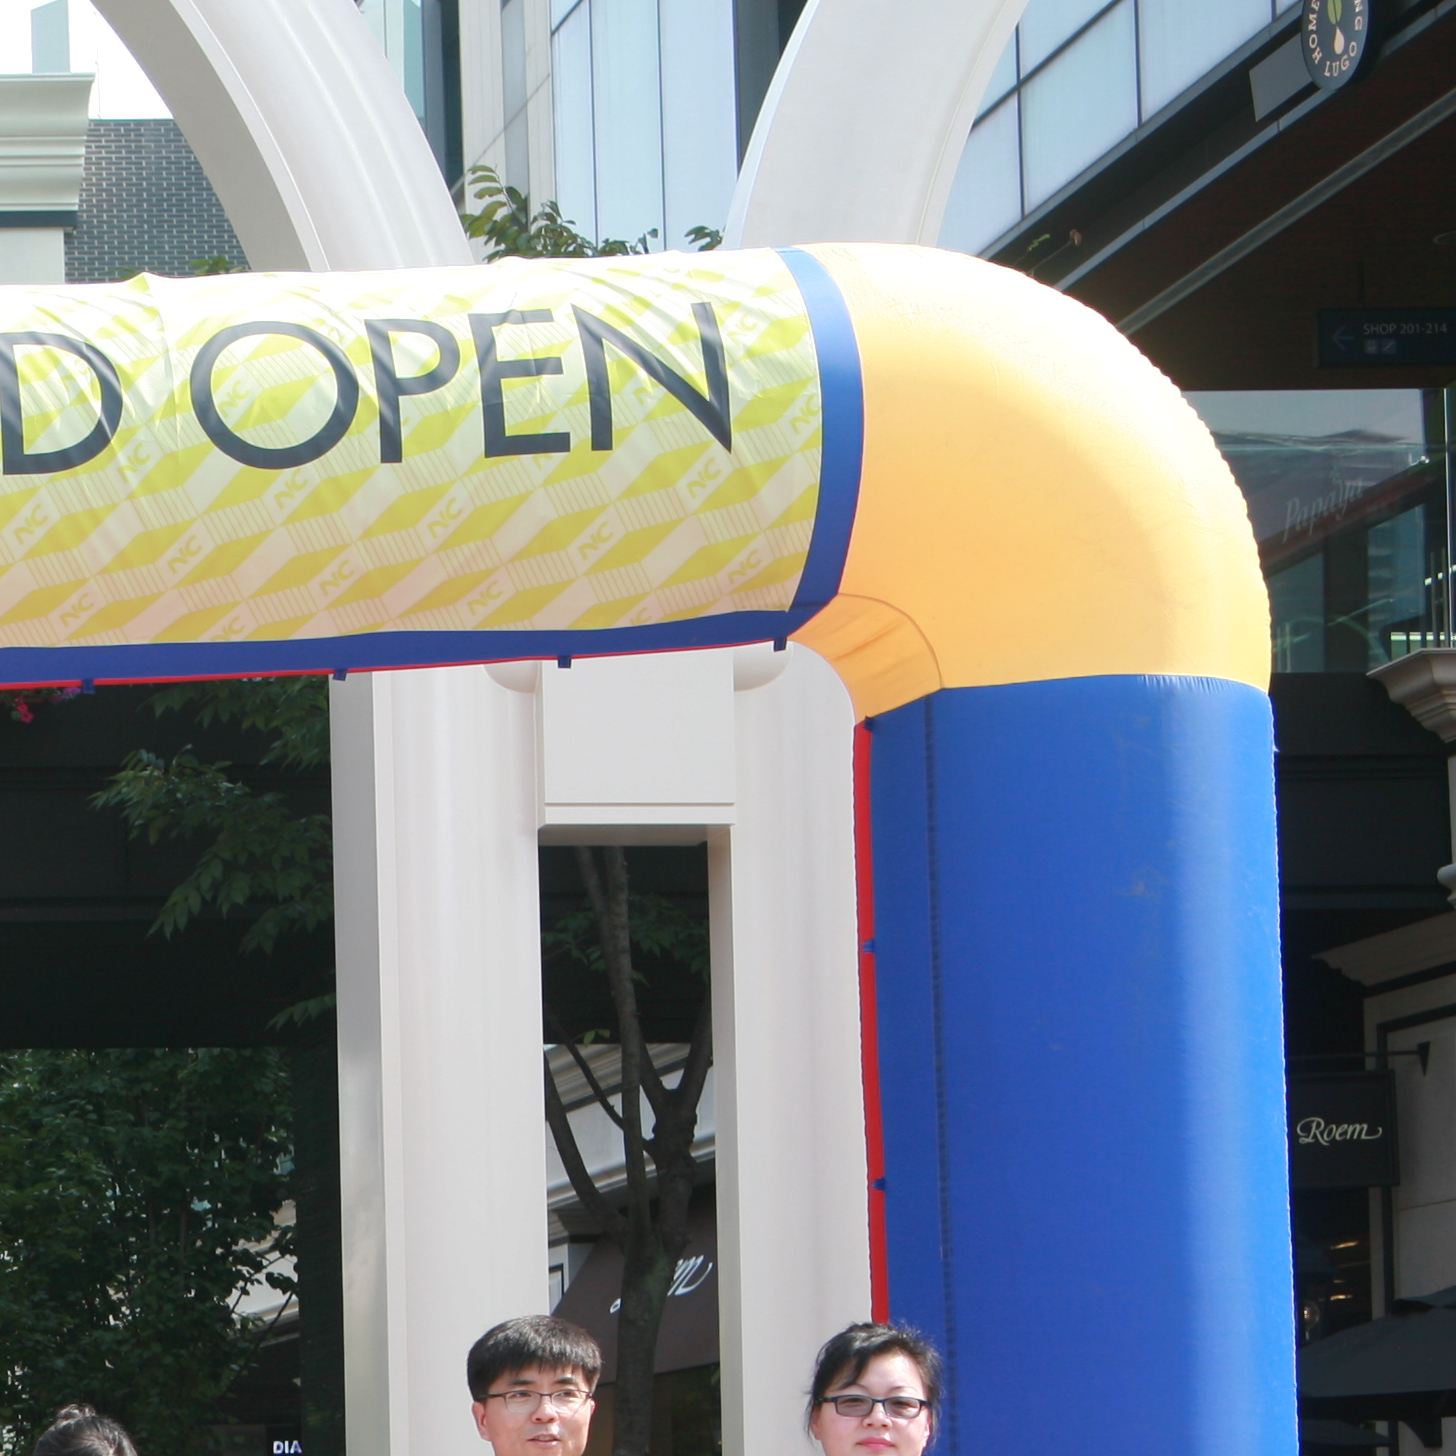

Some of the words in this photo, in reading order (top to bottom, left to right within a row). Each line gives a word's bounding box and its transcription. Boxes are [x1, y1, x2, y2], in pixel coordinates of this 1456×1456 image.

[1324, 41, 1357, 77] LUGO
[727, 313, 758, 345] NC
[1362, 322, 1396, 335] SHOP
[1400, 322, 1448, 335] 201-214
[190, 302, 733, 470] OPEN
[217, 381, 251, 418] NC
[789, 394, 820, 435] NC
[116, 442, 153, 484] NC
[686, 457, 723, 498] NC
[275, 467, 309, 509] NC
[13, 503, 51, 544] NC
[427, 498, 465, 538] NC
[167, 536, 204, 575] NC
[578, 522, 615, 560] NC
[319, 560, 357, 597] NC
[726, 550, 763, 585] NC
[58, 592, 96, 627] NC
[467, 580, 504, 616] NC
[211, 615, 246, 643] NC
[1296, 1117, 1382, 1146] Roem
[272, 1440, 303, 1455] DIA
